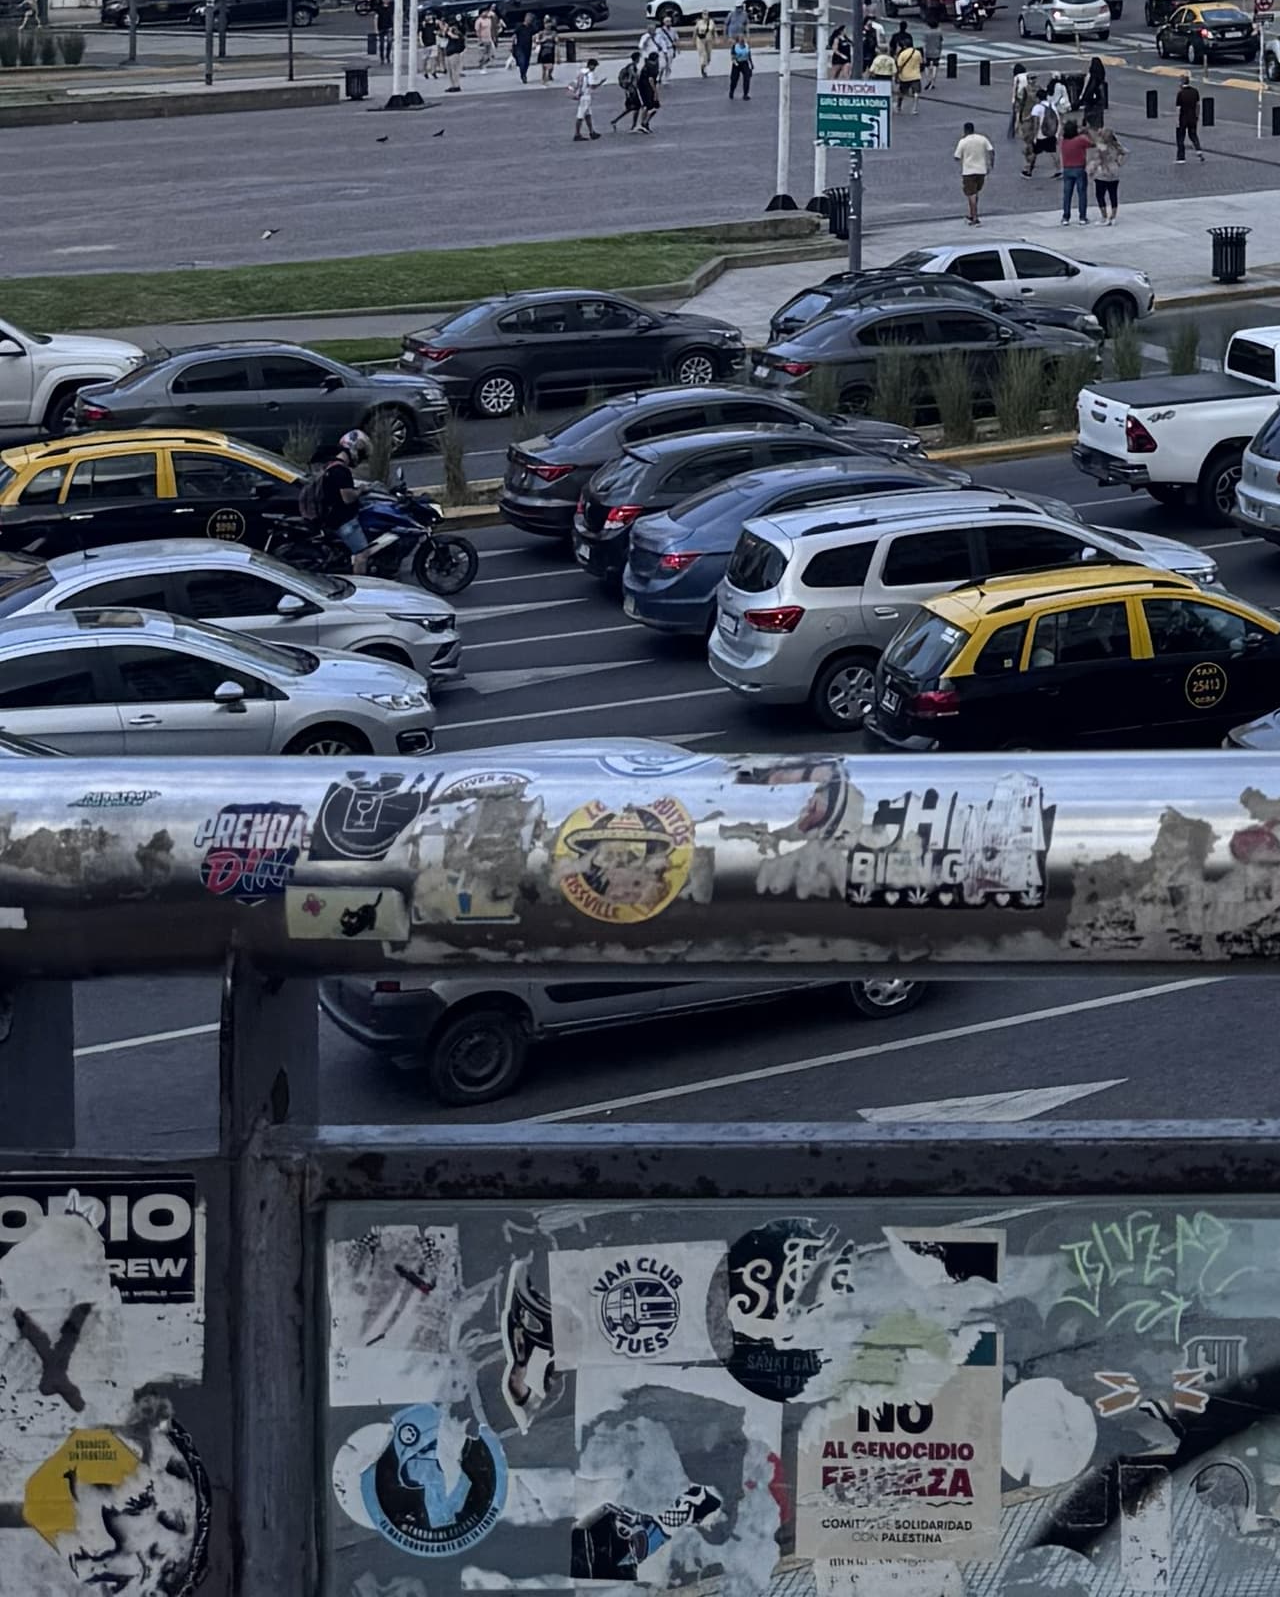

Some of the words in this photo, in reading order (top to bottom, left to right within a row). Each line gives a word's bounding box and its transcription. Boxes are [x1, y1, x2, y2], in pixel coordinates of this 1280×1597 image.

[196, 812, 313, 848] PRENDA
[593, 1261, 633, 1295] VAN
[636, 1256, 683, 1293] CLUB
[613, 1331, 671, 1357] TUES
[747, 1353, 789, 1372] SANKT
[858, 1400, 933, 1434] NO
[823, 1441, 848, 1459] AL
[851, 1441, 974, 1461] GENOCIDIO
[895, 1518, 973, 1531] SOLIDARIDAD
[882, 1533, 942, 1543] PALESTINA
